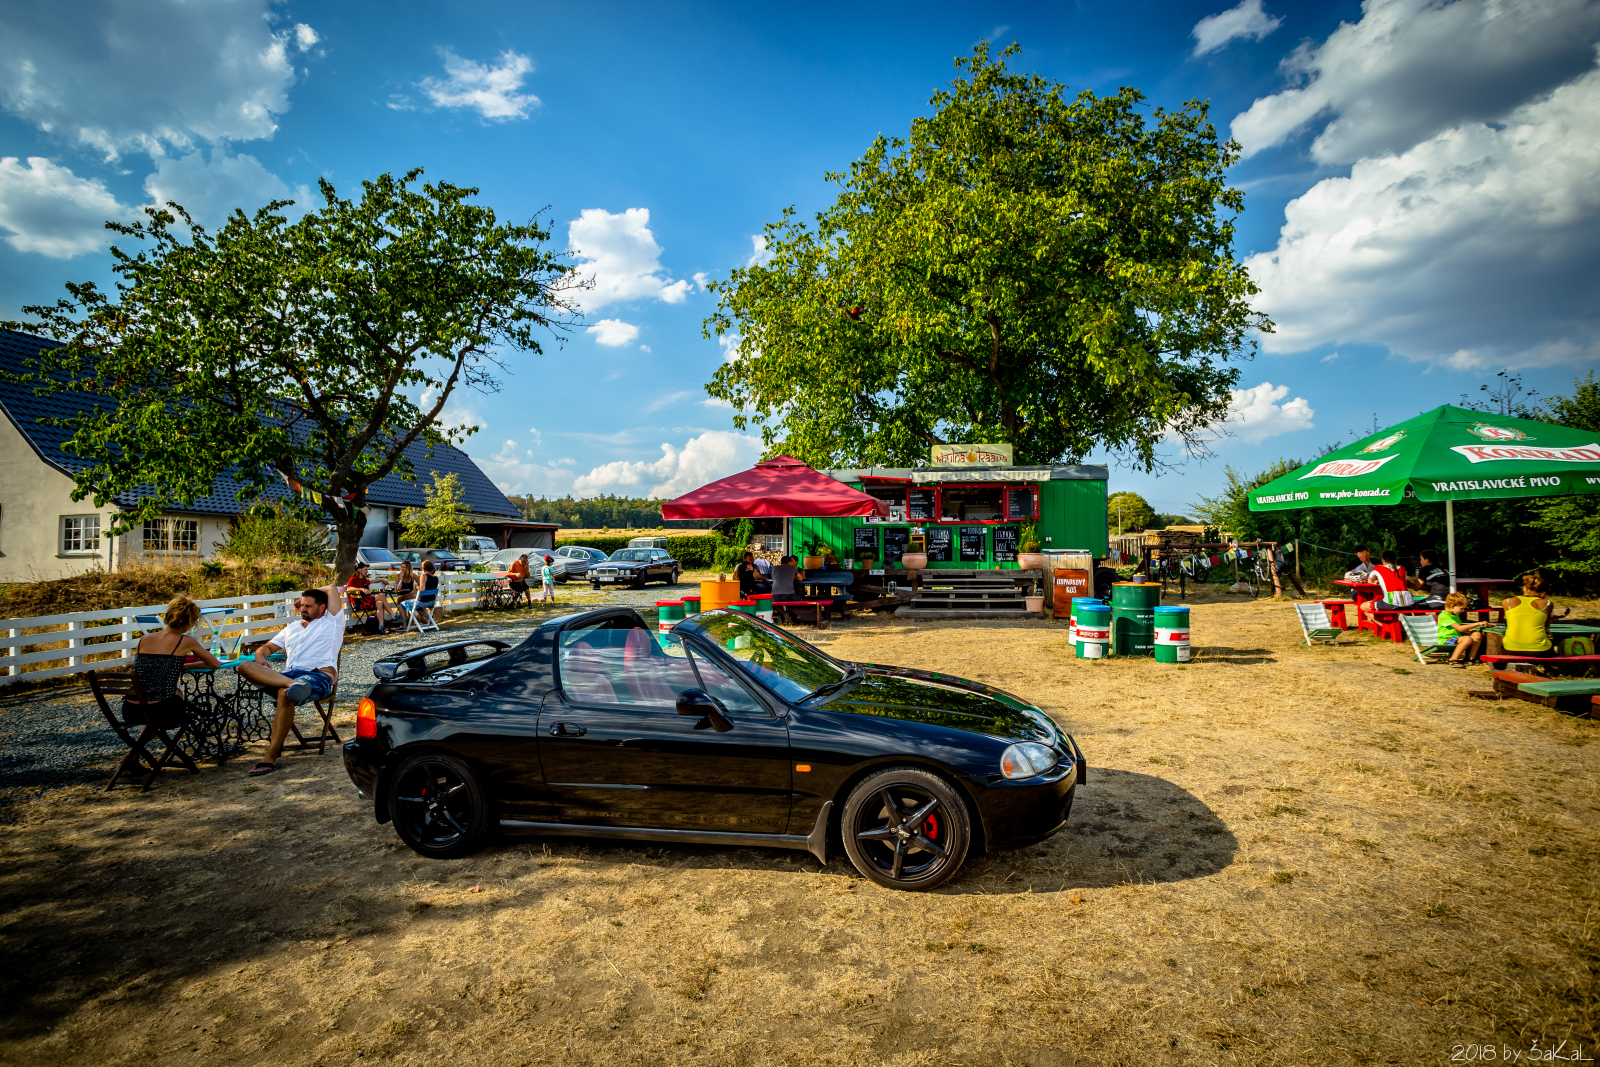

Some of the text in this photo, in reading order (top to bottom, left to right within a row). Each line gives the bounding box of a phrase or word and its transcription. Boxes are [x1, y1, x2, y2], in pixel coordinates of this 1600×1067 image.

[1463, 446, 1600, 460] KONRAD
[1431, 476, 1527, 492] VRATISLAVICKÉ
[1529, 476, 1561, 487] PIVO
[1256, 491, 1294, 504] VRATISLAVICKÉ
[1295, 491, 1309, 501] PIVO
[1319, 487, 1390, 500] www.pivo-konrad.cz
[1056, 578, 1086, 586] ODPADKOVÝ
